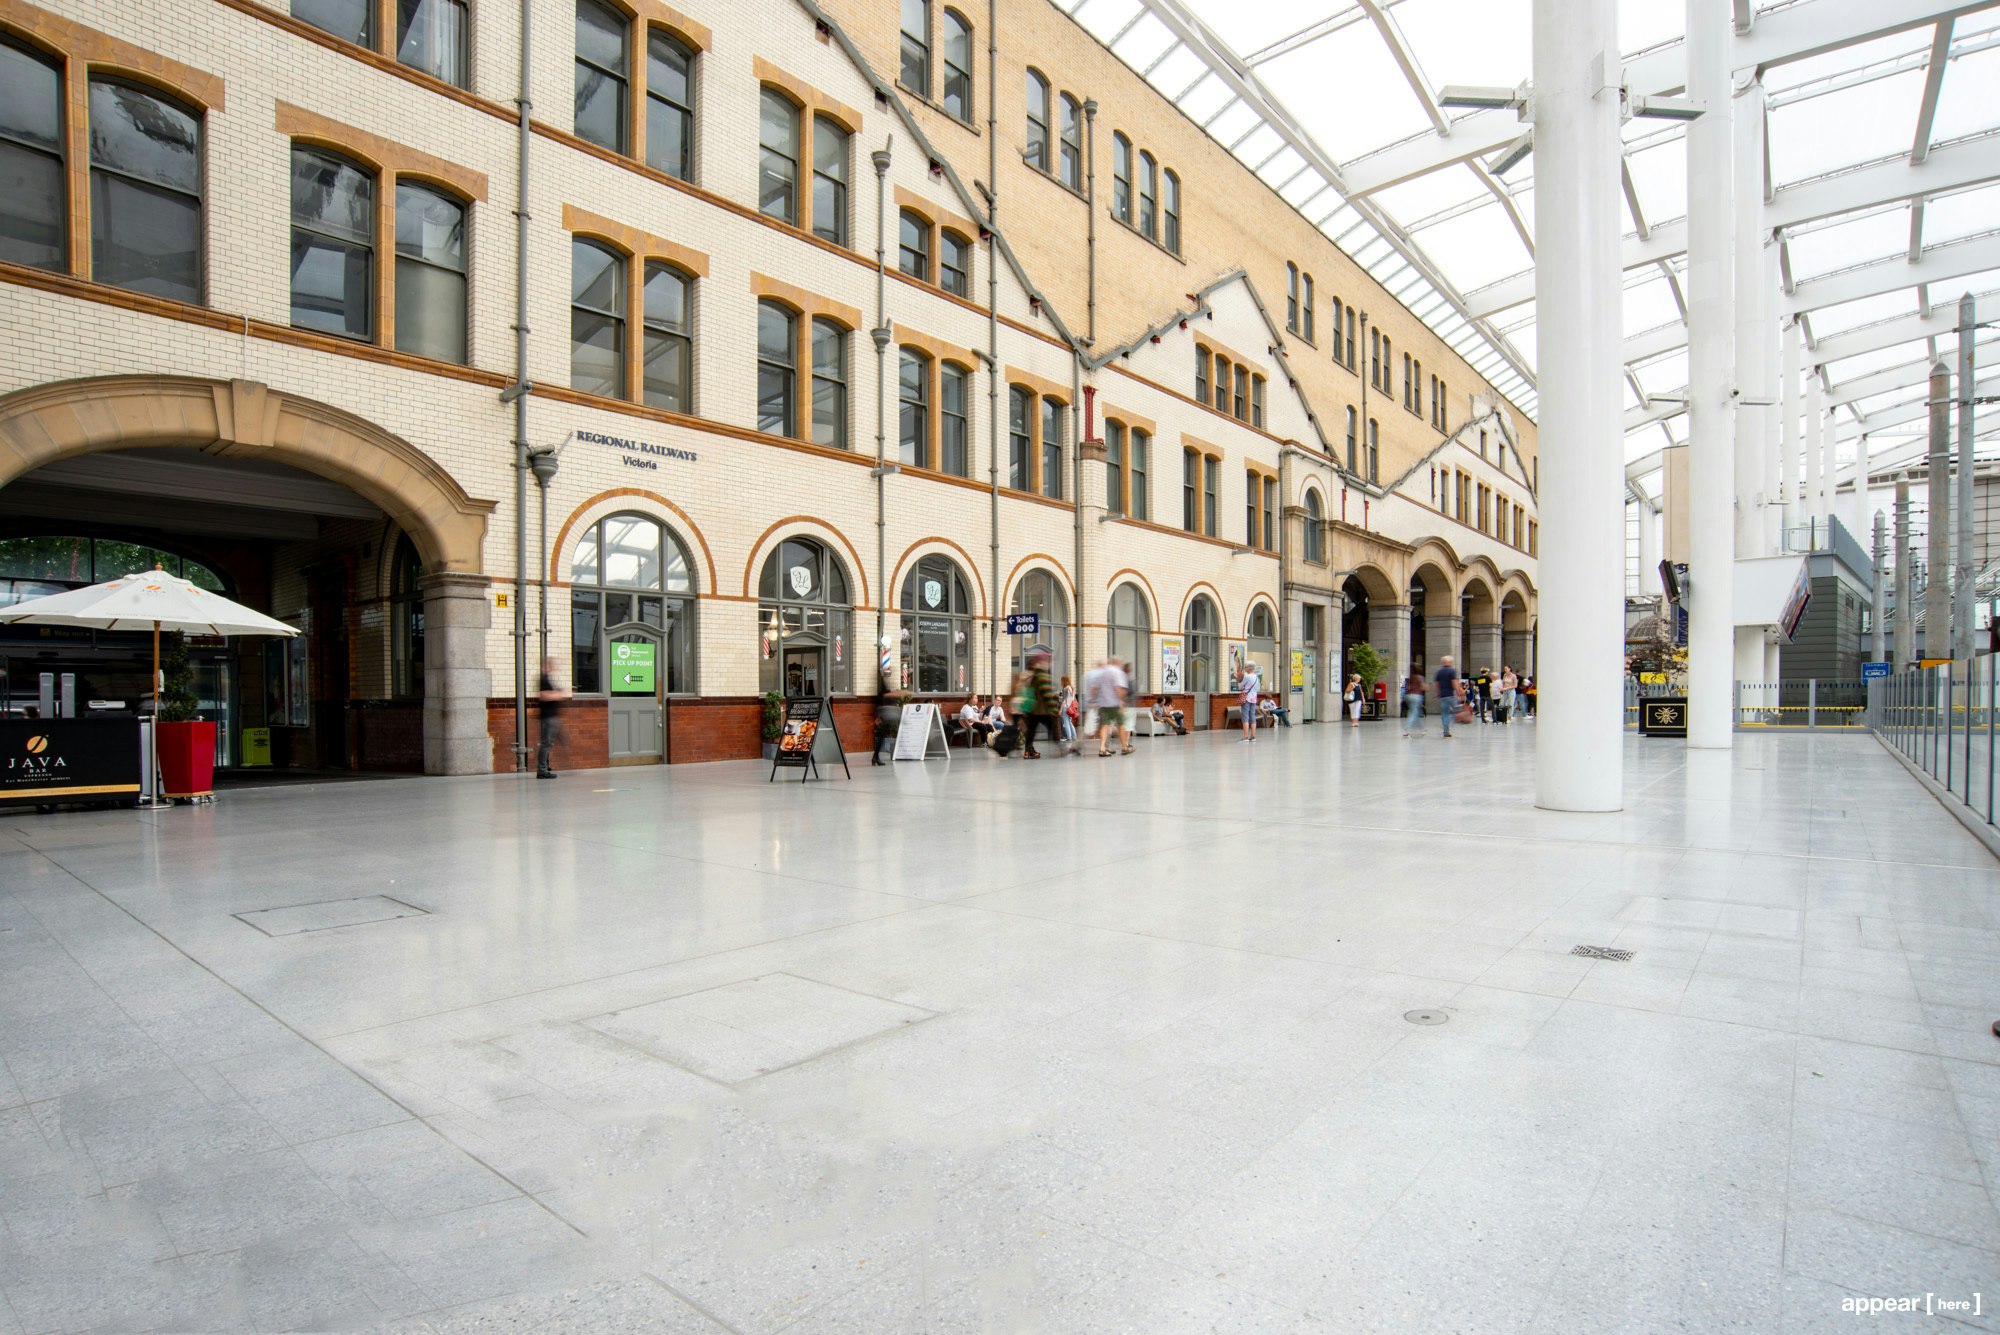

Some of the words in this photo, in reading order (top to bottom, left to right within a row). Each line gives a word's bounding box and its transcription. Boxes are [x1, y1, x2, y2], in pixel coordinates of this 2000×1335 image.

[577, 430, 639, 451] REGIONAL
[640, 442, 697, 462] RAILWAYS
[622, 455, 657, 470] Victoria
[1015, 615, 1035, 624] Toilets
[8, 756, 66, 768] JAVA
